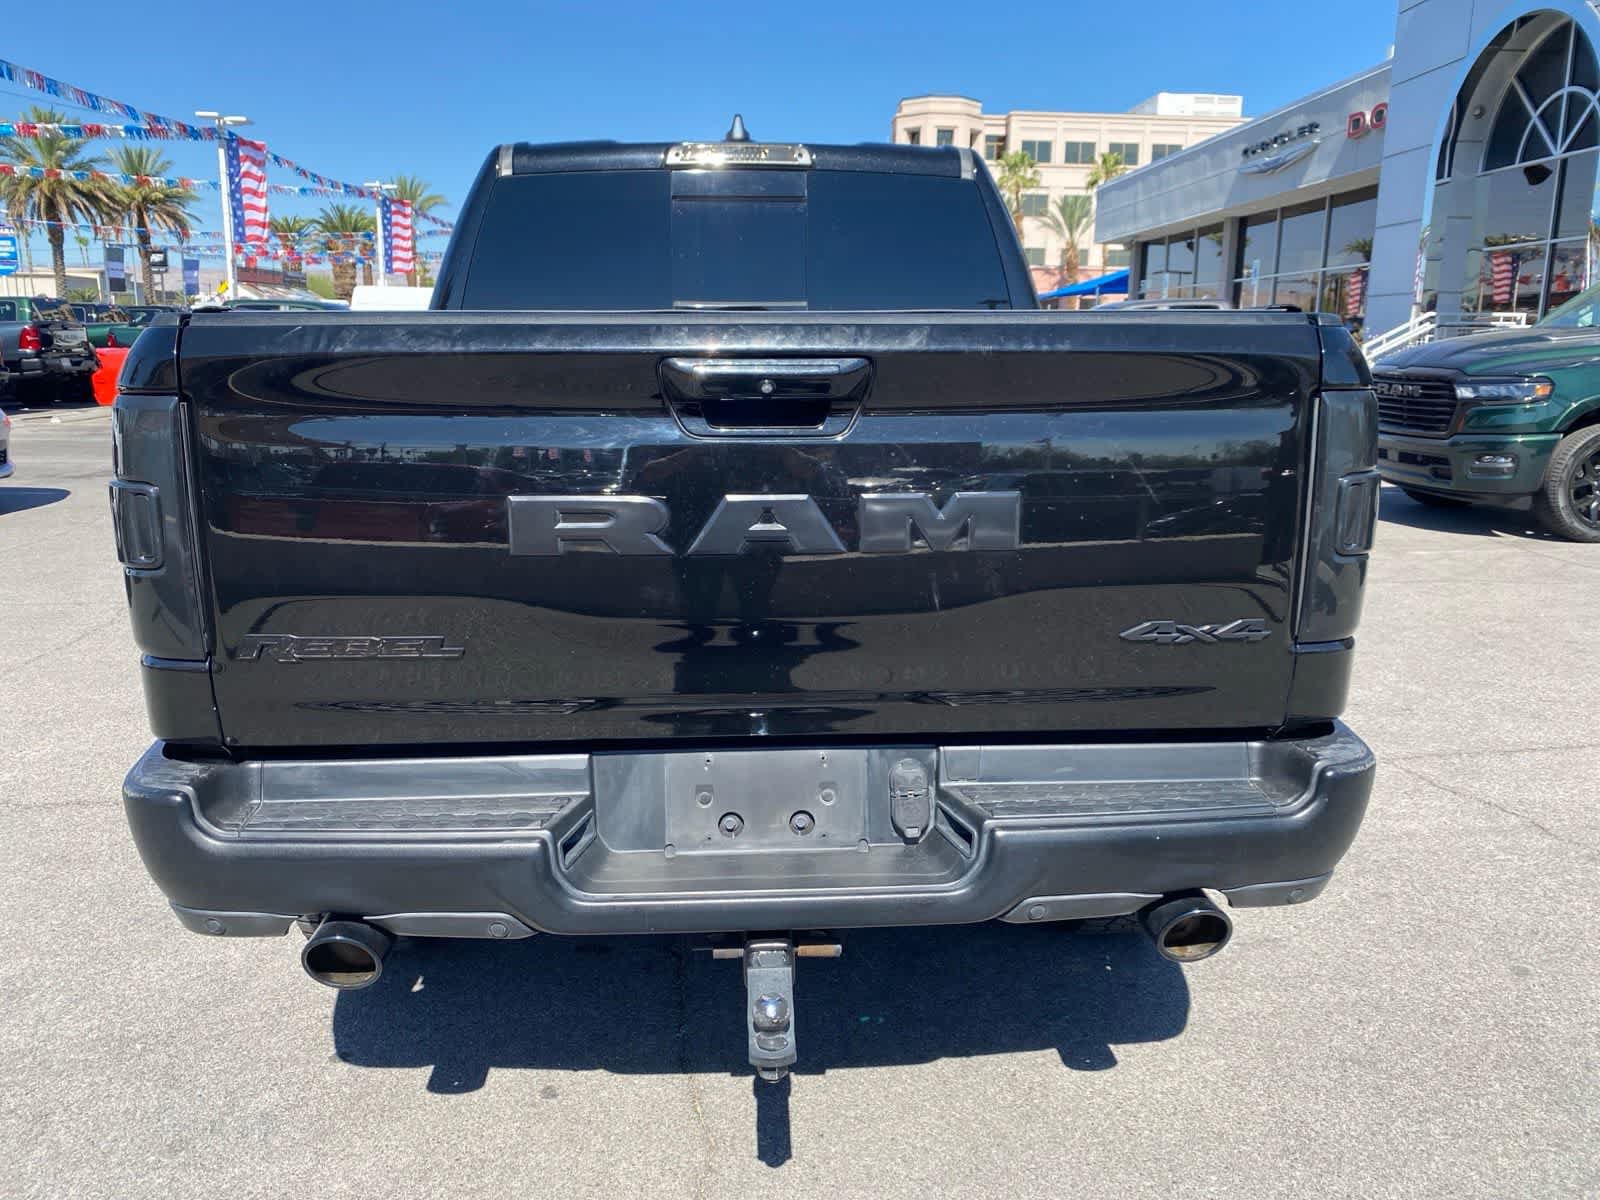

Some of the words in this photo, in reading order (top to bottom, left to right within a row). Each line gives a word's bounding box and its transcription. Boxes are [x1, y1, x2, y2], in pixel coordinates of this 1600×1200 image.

[1376, 383, 1422, 397] RAM
[507, 490, 1022, 556] RAM
[236, 633, 465, 662] REBEL
